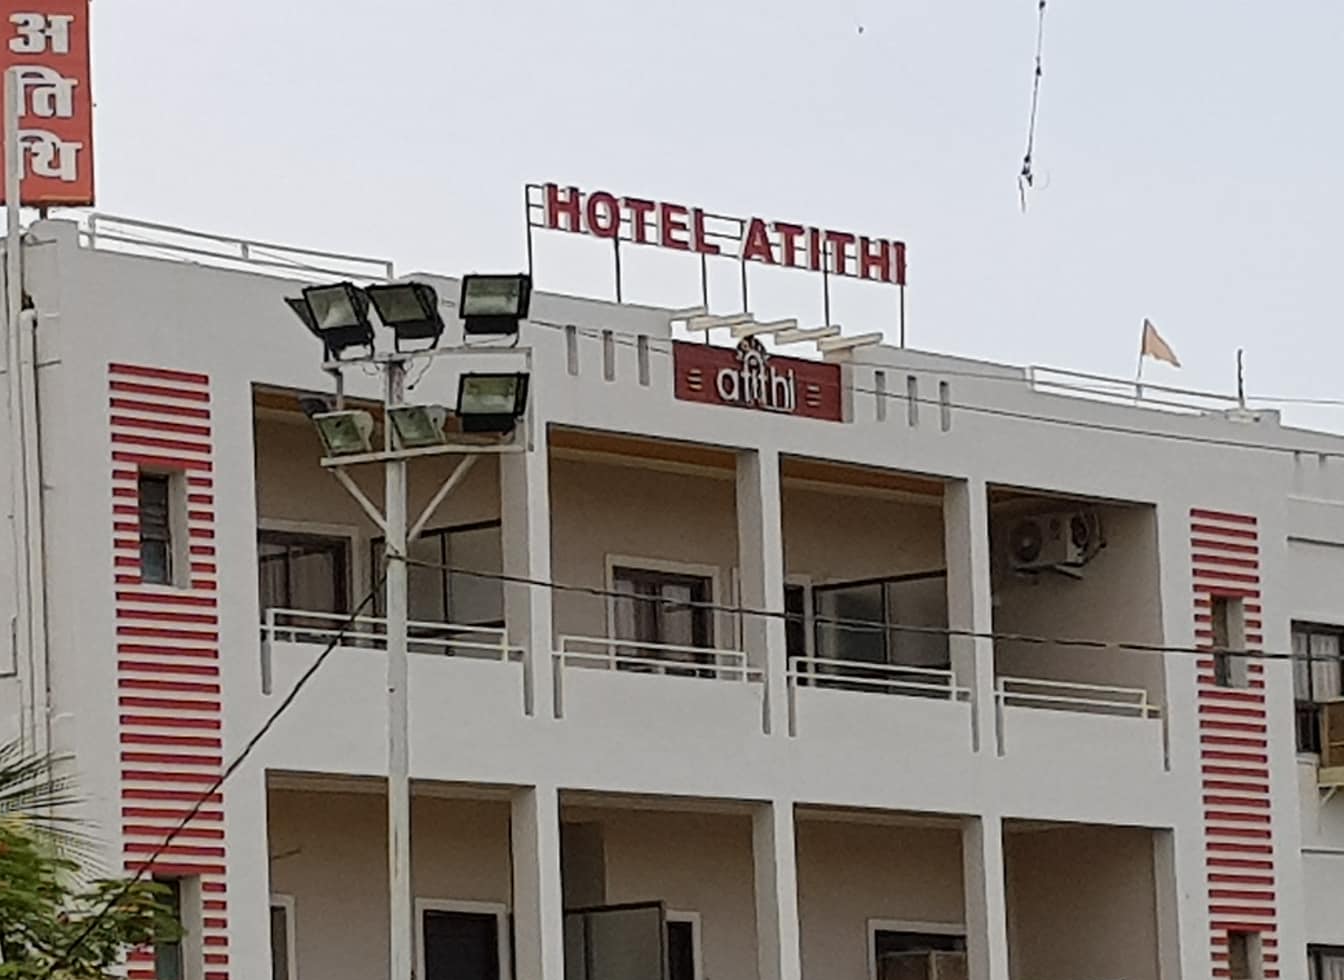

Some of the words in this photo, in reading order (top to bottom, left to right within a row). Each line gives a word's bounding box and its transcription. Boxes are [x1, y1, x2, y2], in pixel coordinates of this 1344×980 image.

[543, 183, 720, 255] HOTEL
[742, 217, 907, 286] ATITHI
[716, 349, 796, 413] atithi
